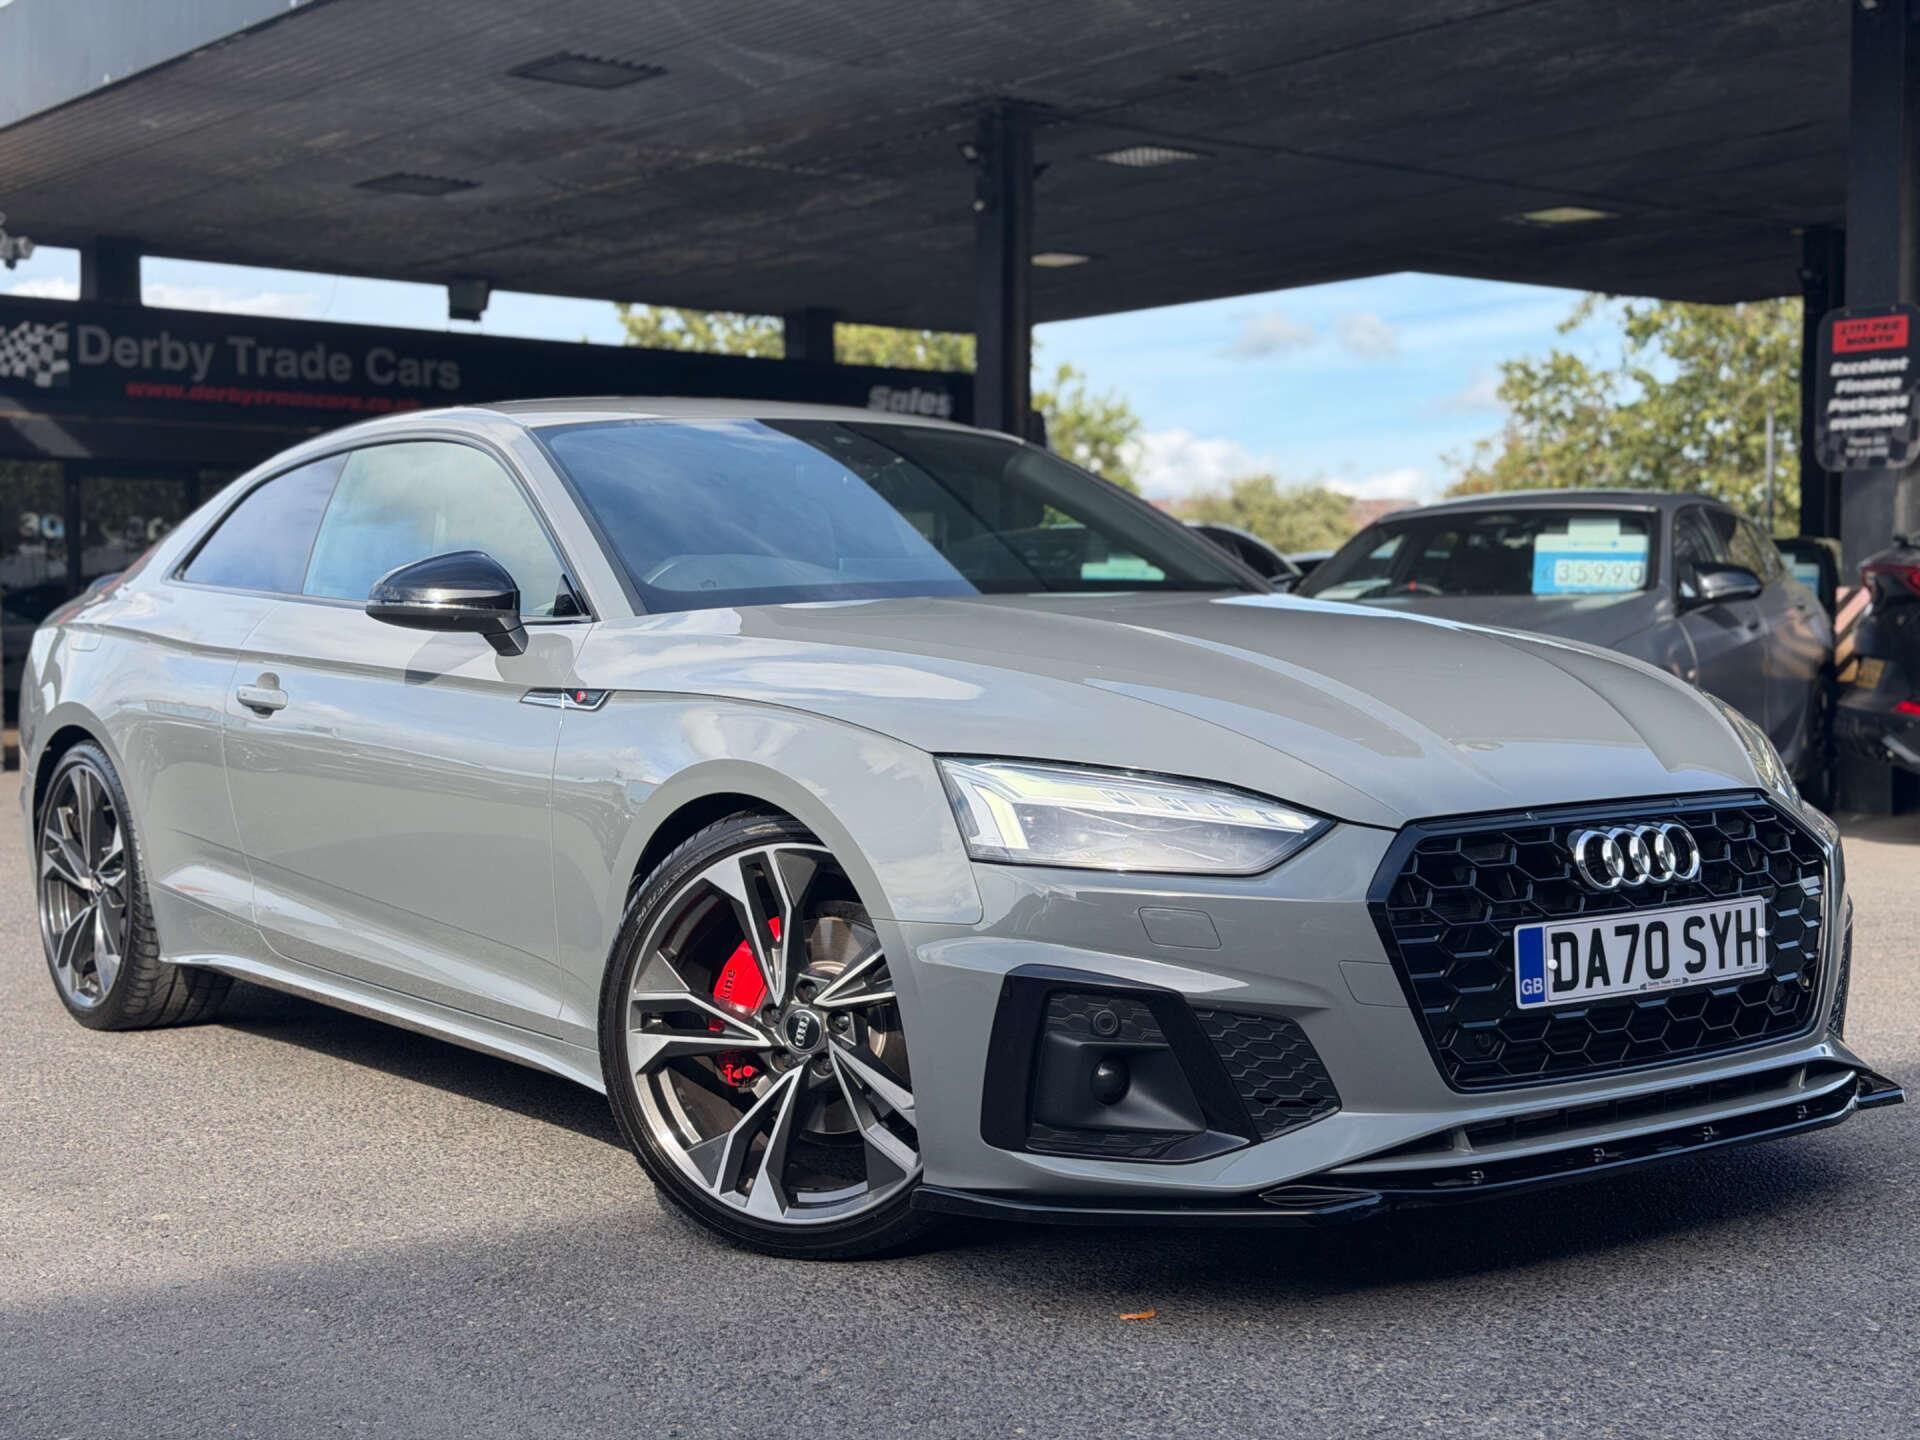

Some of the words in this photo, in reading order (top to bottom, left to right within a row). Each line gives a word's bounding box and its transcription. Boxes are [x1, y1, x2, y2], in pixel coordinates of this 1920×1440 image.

[77, 325, 214, 382] Derby
[227, 336, 351, 382] Trade
[366, 347, 460, 390] Cars
[1551, 921, 1670, 993] DA70
[1683, 906, 1758, 975] SYH
[1521, 977, 1544, 995] GB
